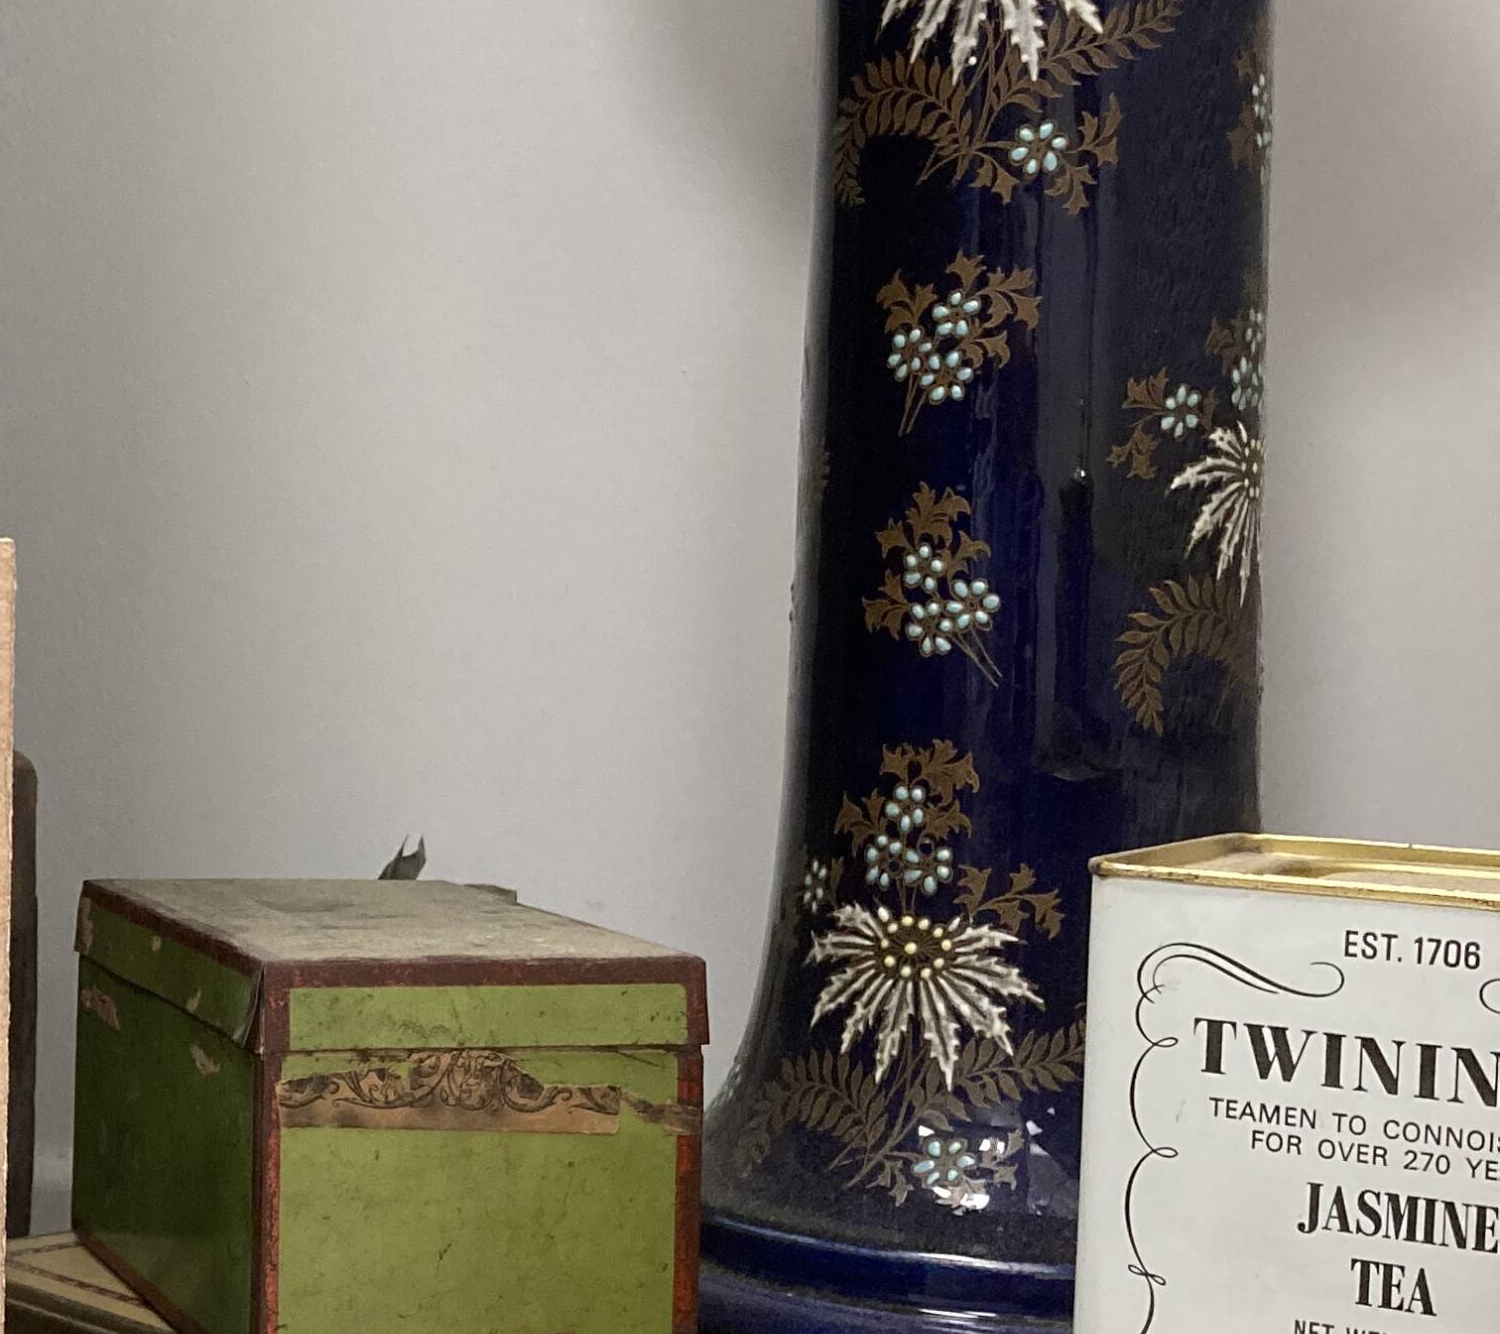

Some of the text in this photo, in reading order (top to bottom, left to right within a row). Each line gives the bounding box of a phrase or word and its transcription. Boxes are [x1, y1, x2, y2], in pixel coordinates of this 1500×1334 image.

[1344, 929, 1481, 970] EST. 1706
[1209, 1097, 1500, 1153] TEAMEN TO CONNOI
[1252, 1129, 1302, 1155] FOR
[1318, 1138, 1388, 1166] OVER
[1404, 1150, 1450, 1175] 270
[1297, 1181, 1499, 1254] JASMINE
[1351, 1258, 1437, 1316] TEA
